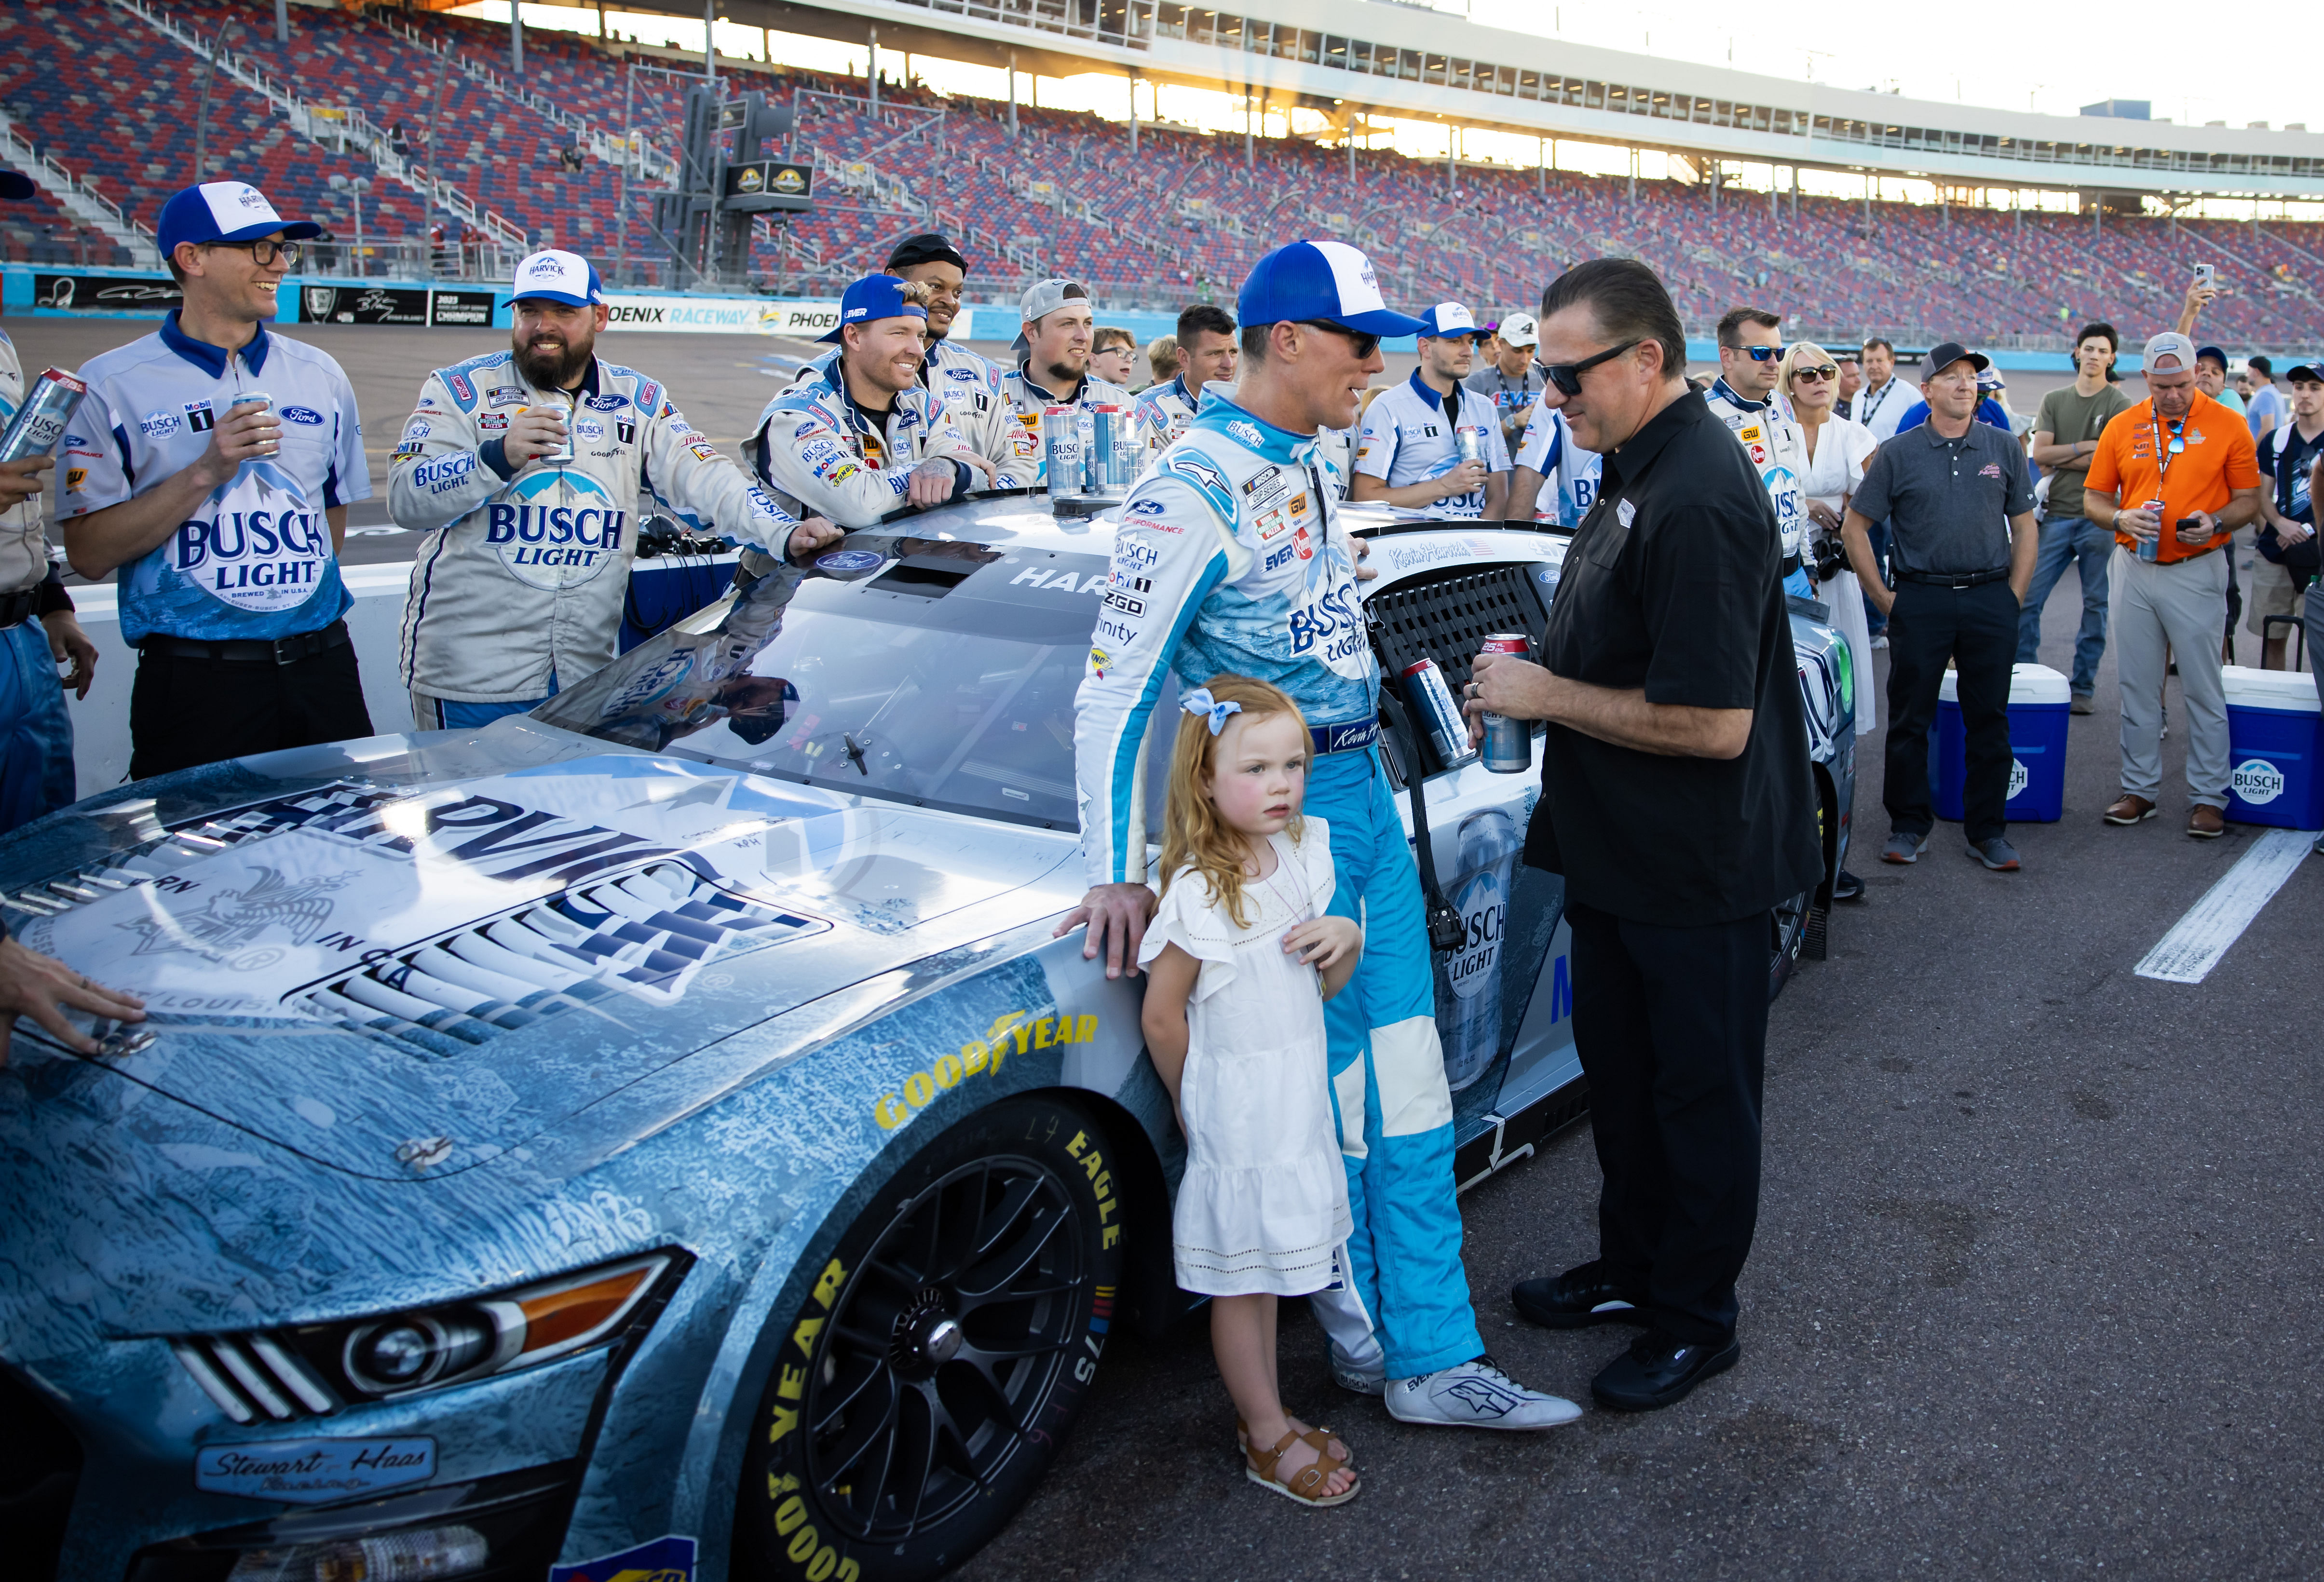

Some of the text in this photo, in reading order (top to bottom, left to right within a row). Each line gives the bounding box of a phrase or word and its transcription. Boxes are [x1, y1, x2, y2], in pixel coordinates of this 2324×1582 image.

[530, 266, 565, 275] HARVICK
[437, 295, 458, 304] 2023
[436, 311, 486, 322] CHAMPION
[669, 308, 750, 325] RACEWAY
[843, 308, 867, 318] 4EVER
[1025, 306, 1033, 317] 4
[1520, 322, 1534, 335] 4
[951, 370, 975, 379] Ford
[452, 376, 470, 398] SIMPSON
[642, 384, 656, 404] SIMPSON
[184, 400, 211, 412] Mobil
[591, 397, 620, 411] Ford
[140, 414, 182, 434] BUSCH
[195, 412, 208, 430] 1
[289, 408, 316, 423] Ford
[810, 406, 834, 426] SIMPSON
[27, 427, 55, 442] LIGHT
[151, 427, 176, 437] LIGHT
[576, 424, 604, 434] BUSCH
[622, 424, 627, 441] 1
[797, 422, 815, 436] Ford
[1227, 422, 1264, 447] BUSCH
[1743, 429, 1758, 439] GW
[1231, 433, 1252, 446] LIGHT
[802, 440, 836, 463] BUSCH
[815, 448, 833, 461] LIGHT
[415, 455, 476, 487] BUSCH
[813, 453, 841, 478] Mobil
[1253, 468, 1276, 488] NASCAR
[1253, 478, 1281, 503] CUP SERIES
[1267, 491, 1285, 505] CHAMPION
[1291, 495, 1306, 514] GW
[486, 503, 626, 551] BUSCH
[1125, 517, 1185, 535] PERFORMANCE
[1257, 515, 1283, 535] BROTHERS
[1260, 512, 1275, 526] HUNT
[176, 509, 327, 569] BUSCH
[1265, 525, 1281, 539] PIZZA
[514, 547, 598, 567] LIGHT
[1115, 538, 1158, 566] BUSCH
[1388, 541, 1471, 569] Kevin Harvick
[829, 552, 867, 570] Ford
[1117, 557, 1143, 571] LIGHT
[215, 560, 316, 590] LIGHT
[1482, 642, 1496, 651] 25
[1334, 727, 1367, 748] Kevin
[2234, 773, 2281, 790] BUSCH
[2243, 787, 2271, 795] LIGHT
[316, 931, 366, 953] IN
[1453, 946, 1494, 982] LIGHT
[874, 1010, 1099, 1130] GOODYEAR
[1065, 1130, 1120, 1251] EAGLE
[1340, 1374, 1369, 1390] BUSCH
[204, 1450, 333, 1476] Stewart
[350, 1445, 426, 1472] Haas
